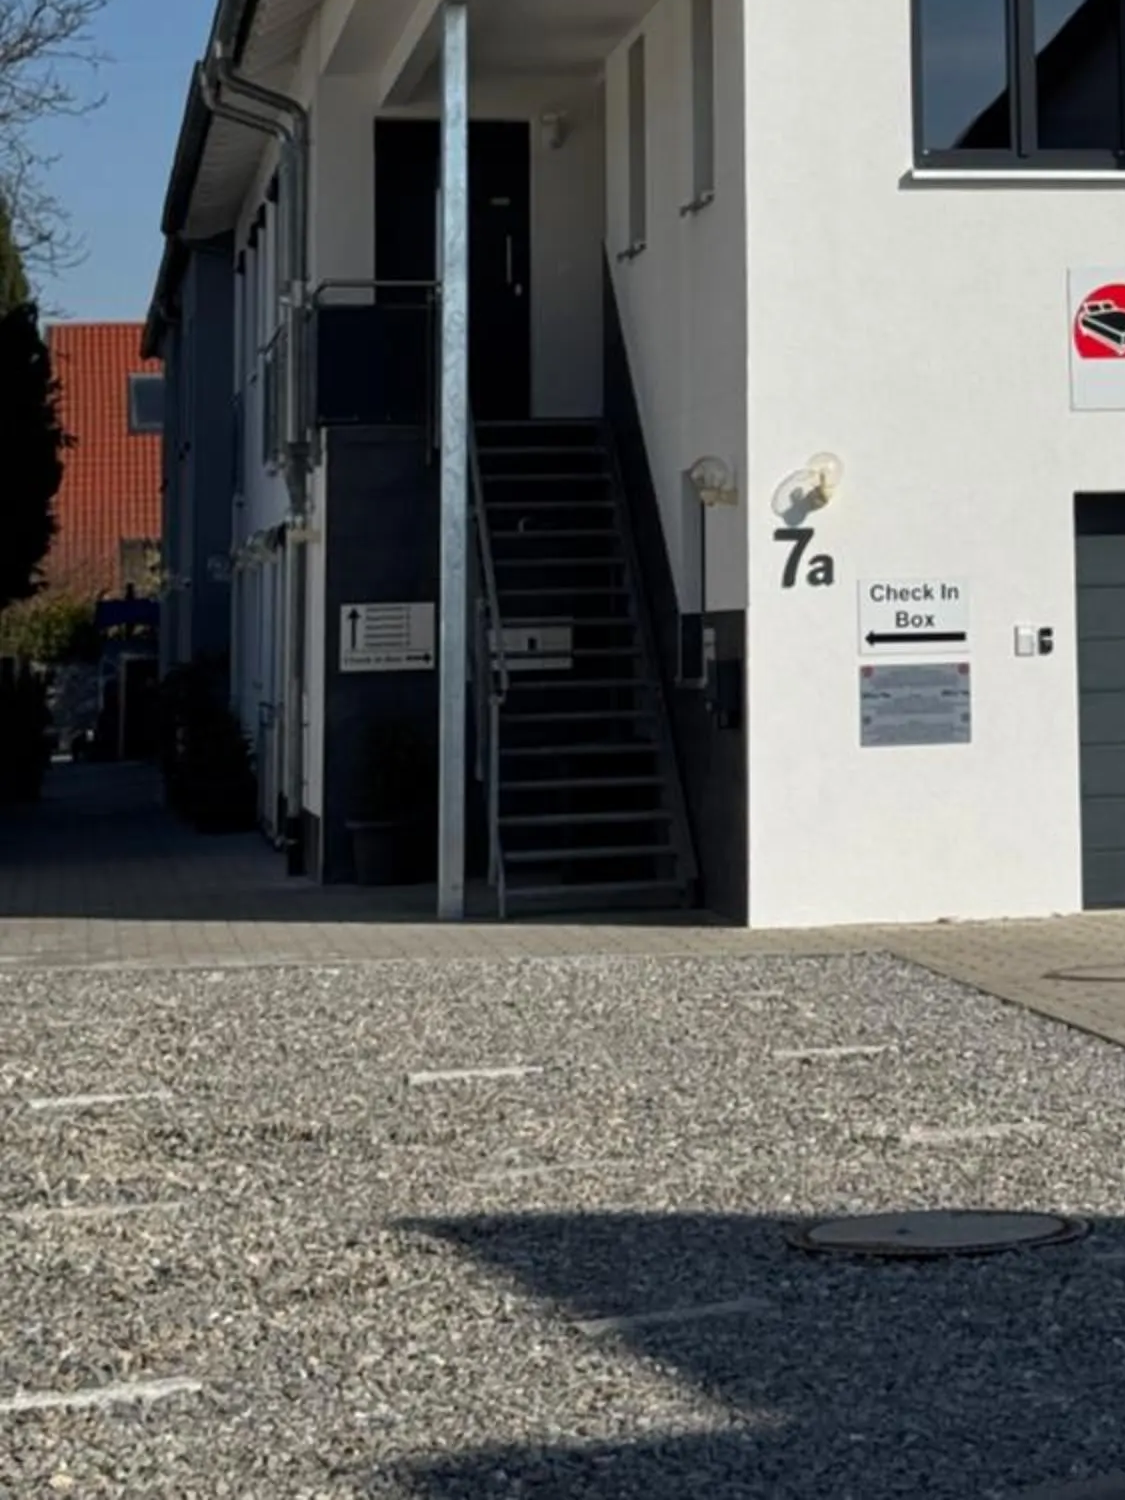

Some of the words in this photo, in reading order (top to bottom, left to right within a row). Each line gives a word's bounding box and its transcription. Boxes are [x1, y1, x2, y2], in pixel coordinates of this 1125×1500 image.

[773, 527, 835, 589] 7a
[869, 583, 935, 602] Check
[940, 583, 960, 601] In
[895, 611, 935, 629] Box
